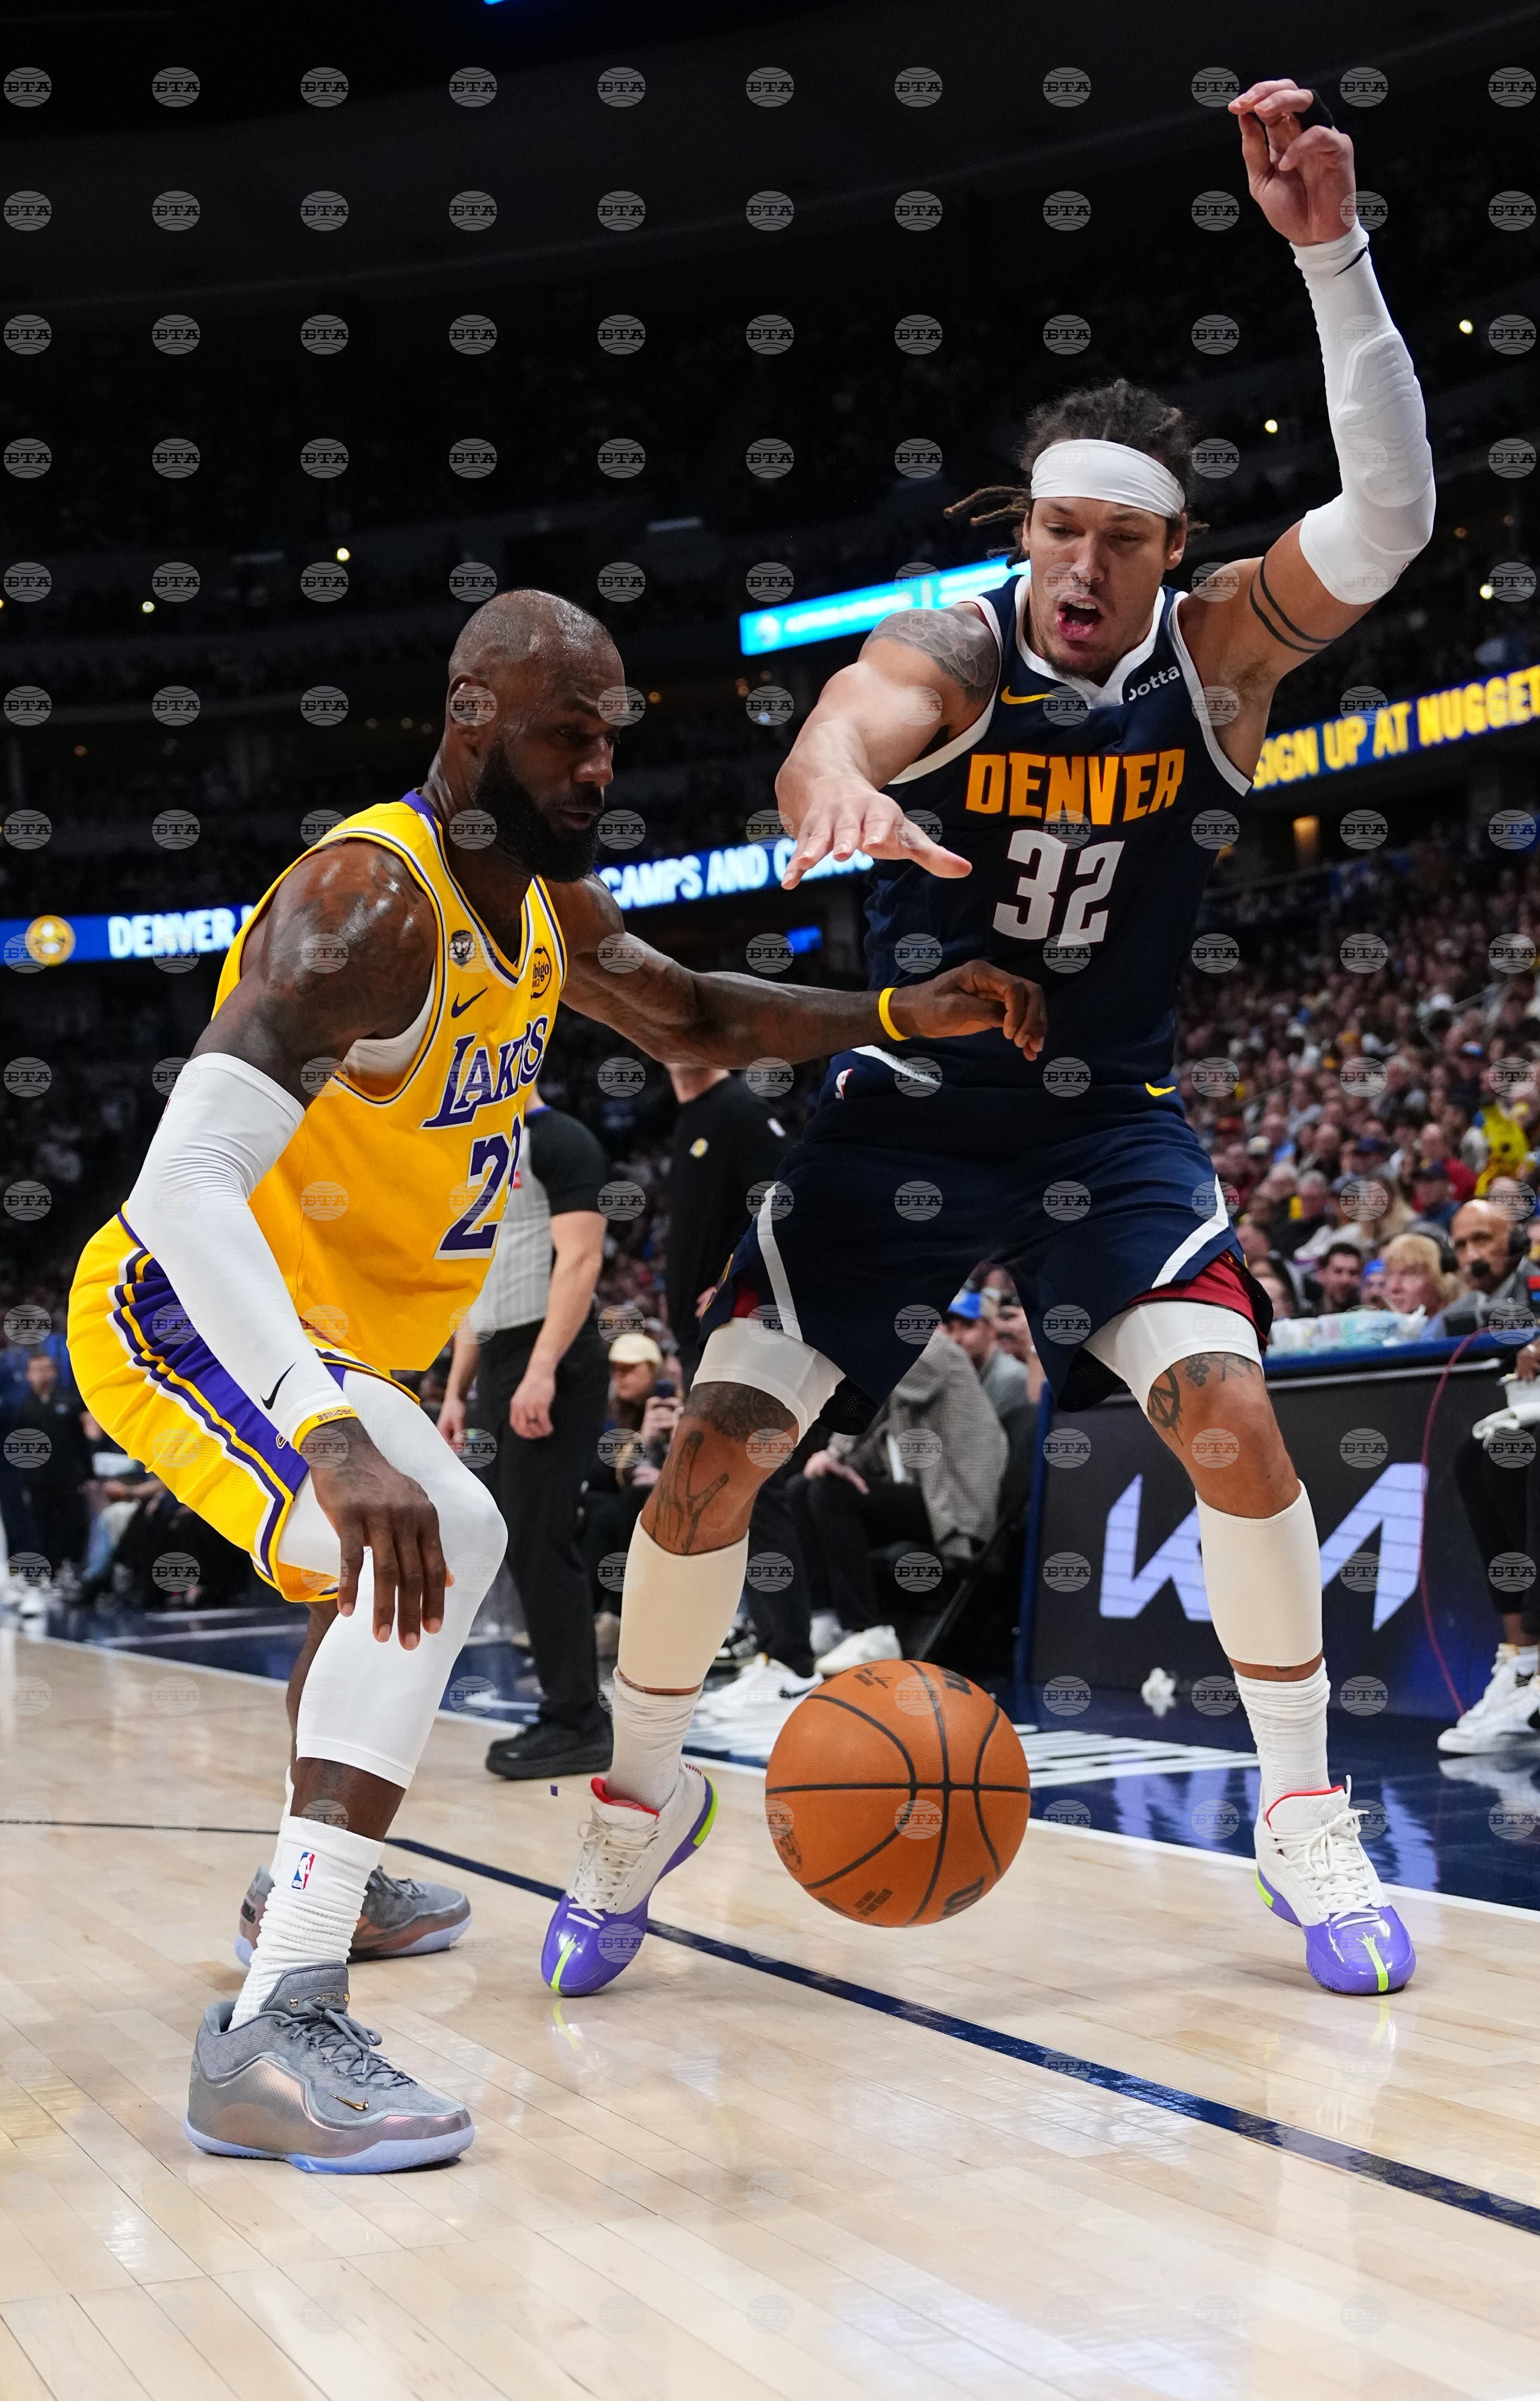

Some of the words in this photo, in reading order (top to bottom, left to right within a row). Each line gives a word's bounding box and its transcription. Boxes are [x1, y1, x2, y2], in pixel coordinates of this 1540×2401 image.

[1323, 716, 1367, 770] UP
[1372, 701, 1412, 760] AT
[965, 748, 1185, 826] DENVER
[598, 855, 704, 910] CAMPS
[706, 844, 770, 895] AND
[992, 828, 1126, 947] 32
[107, 907, 236, 959] DENVER
